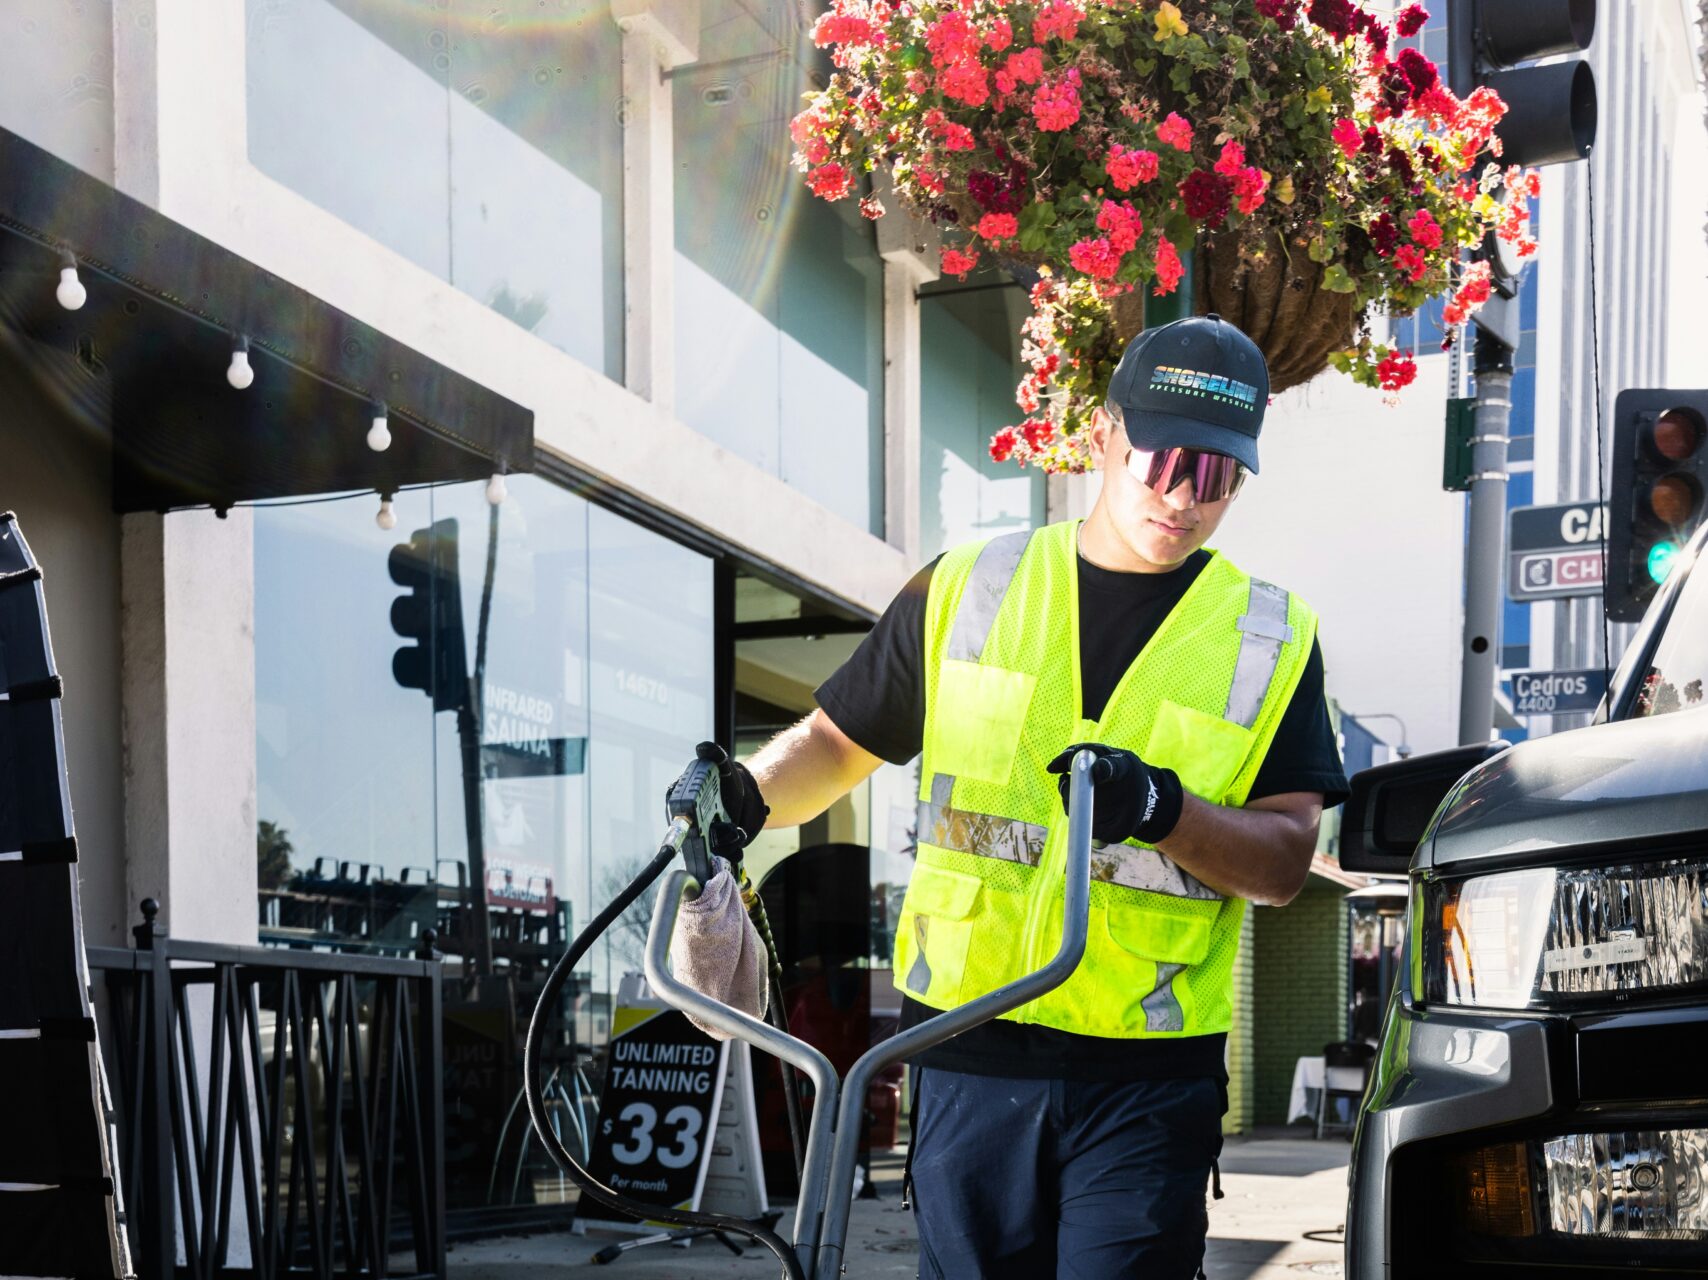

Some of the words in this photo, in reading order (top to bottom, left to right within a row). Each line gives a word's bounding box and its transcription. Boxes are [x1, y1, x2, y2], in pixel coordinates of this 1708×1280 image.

[1151, 365, 1258, 403] SHORELINE
[616, 669, 668, 705] 14670
[1516, 674, 1588, 698] Cedros
[485, 683, 554, 724] INFRARED
[1516, 695, 1556, 712] 4400
[485, 712, 551, 758] SAUNA
[615, 1041, 715, 1066] UNLIMITED
[611, 1066, 710, 1095] TANNING
[610, 1173, 630, 1187] Per
[631, 1177, 668, 1192] month
